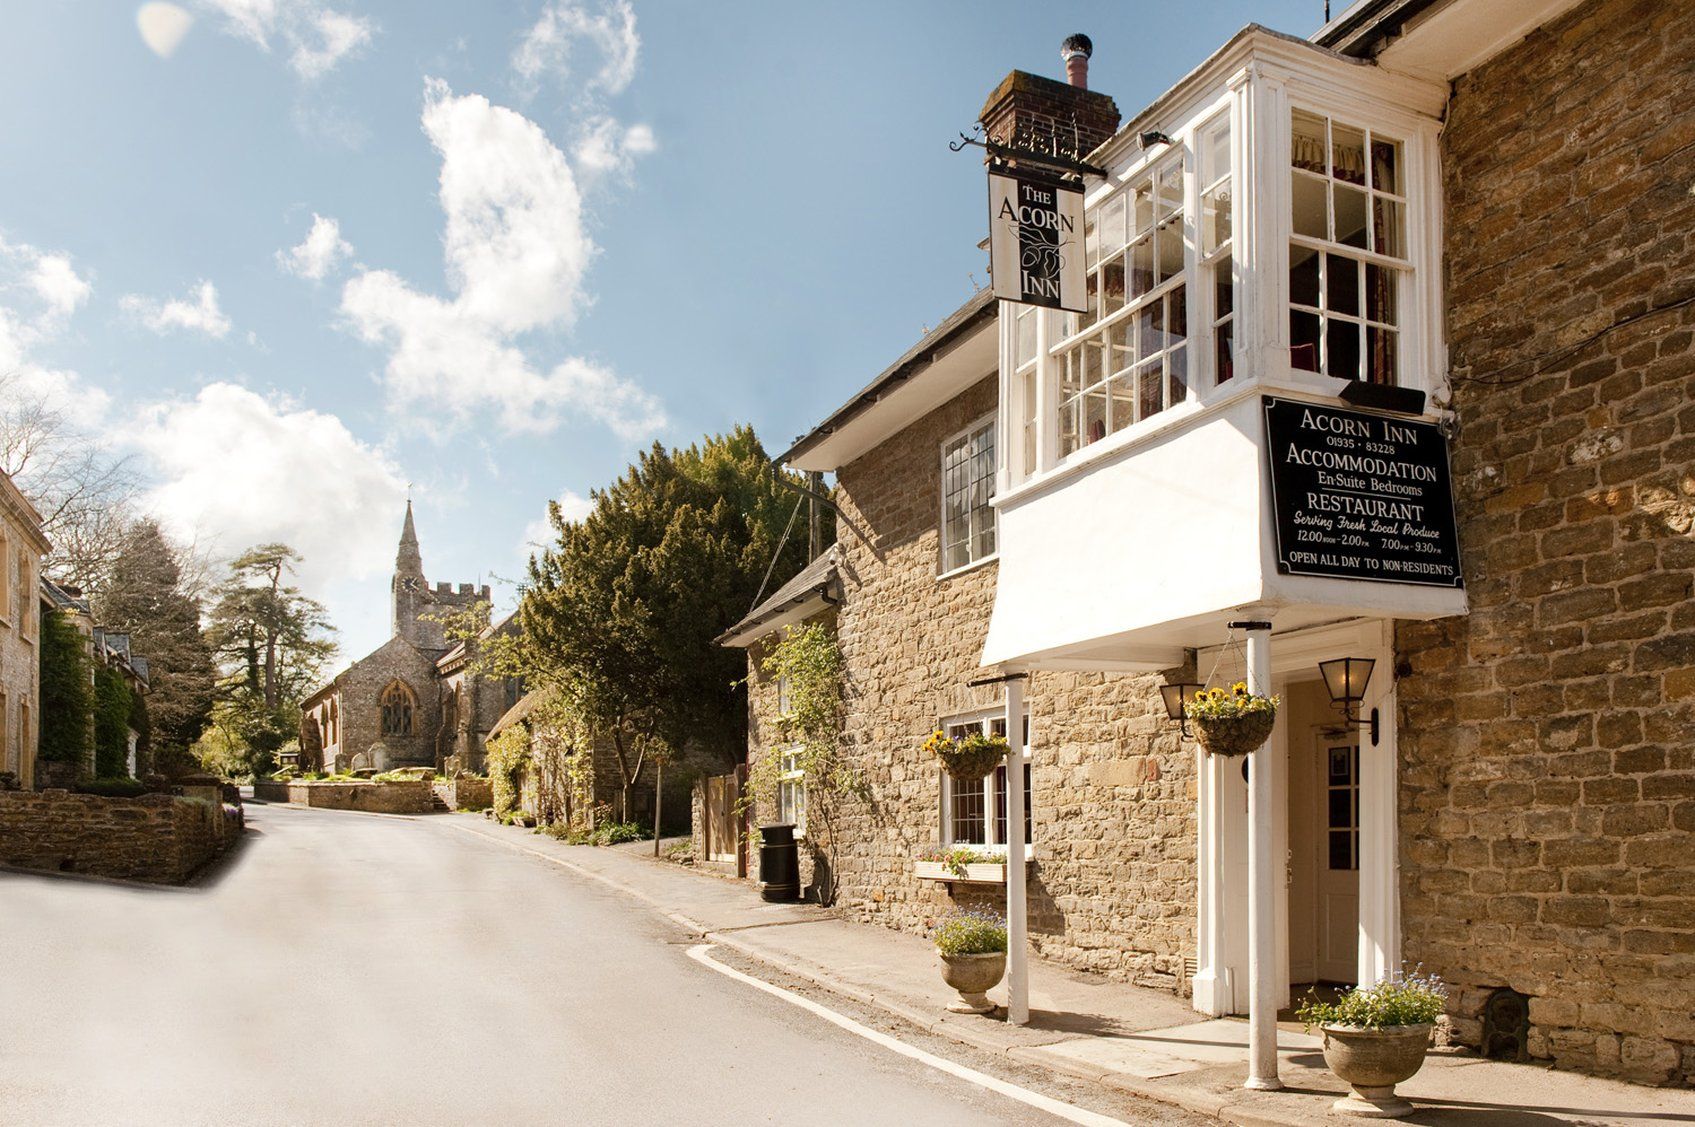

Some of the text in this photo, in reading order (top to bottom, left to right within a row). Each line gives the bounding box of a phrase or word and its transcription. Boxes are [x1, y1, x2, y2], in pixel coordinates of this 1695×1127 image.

[1022, 184, 1051, 205] THE
[998, 196, 1074, 233] ACORN
[1021, 269, 1060, 299] INN
[1300, 408, 1418, 445] ACORN INN
[1286, 442, 1437, 483] ACCOMMODATION
[1371, 478, 1423, 497] Bedrooms
[1307, 492, 1424, 522] RESTAURANT
[1293, 510, 1440, 539] Serving Fresh Local Produce
[1289, 551, 1318, 564] OPEN
[1320, 553, 1339, 566] ALL
[1341, 555, 1361, 568] DAY
[1364, 557, 1379, 570] TO
